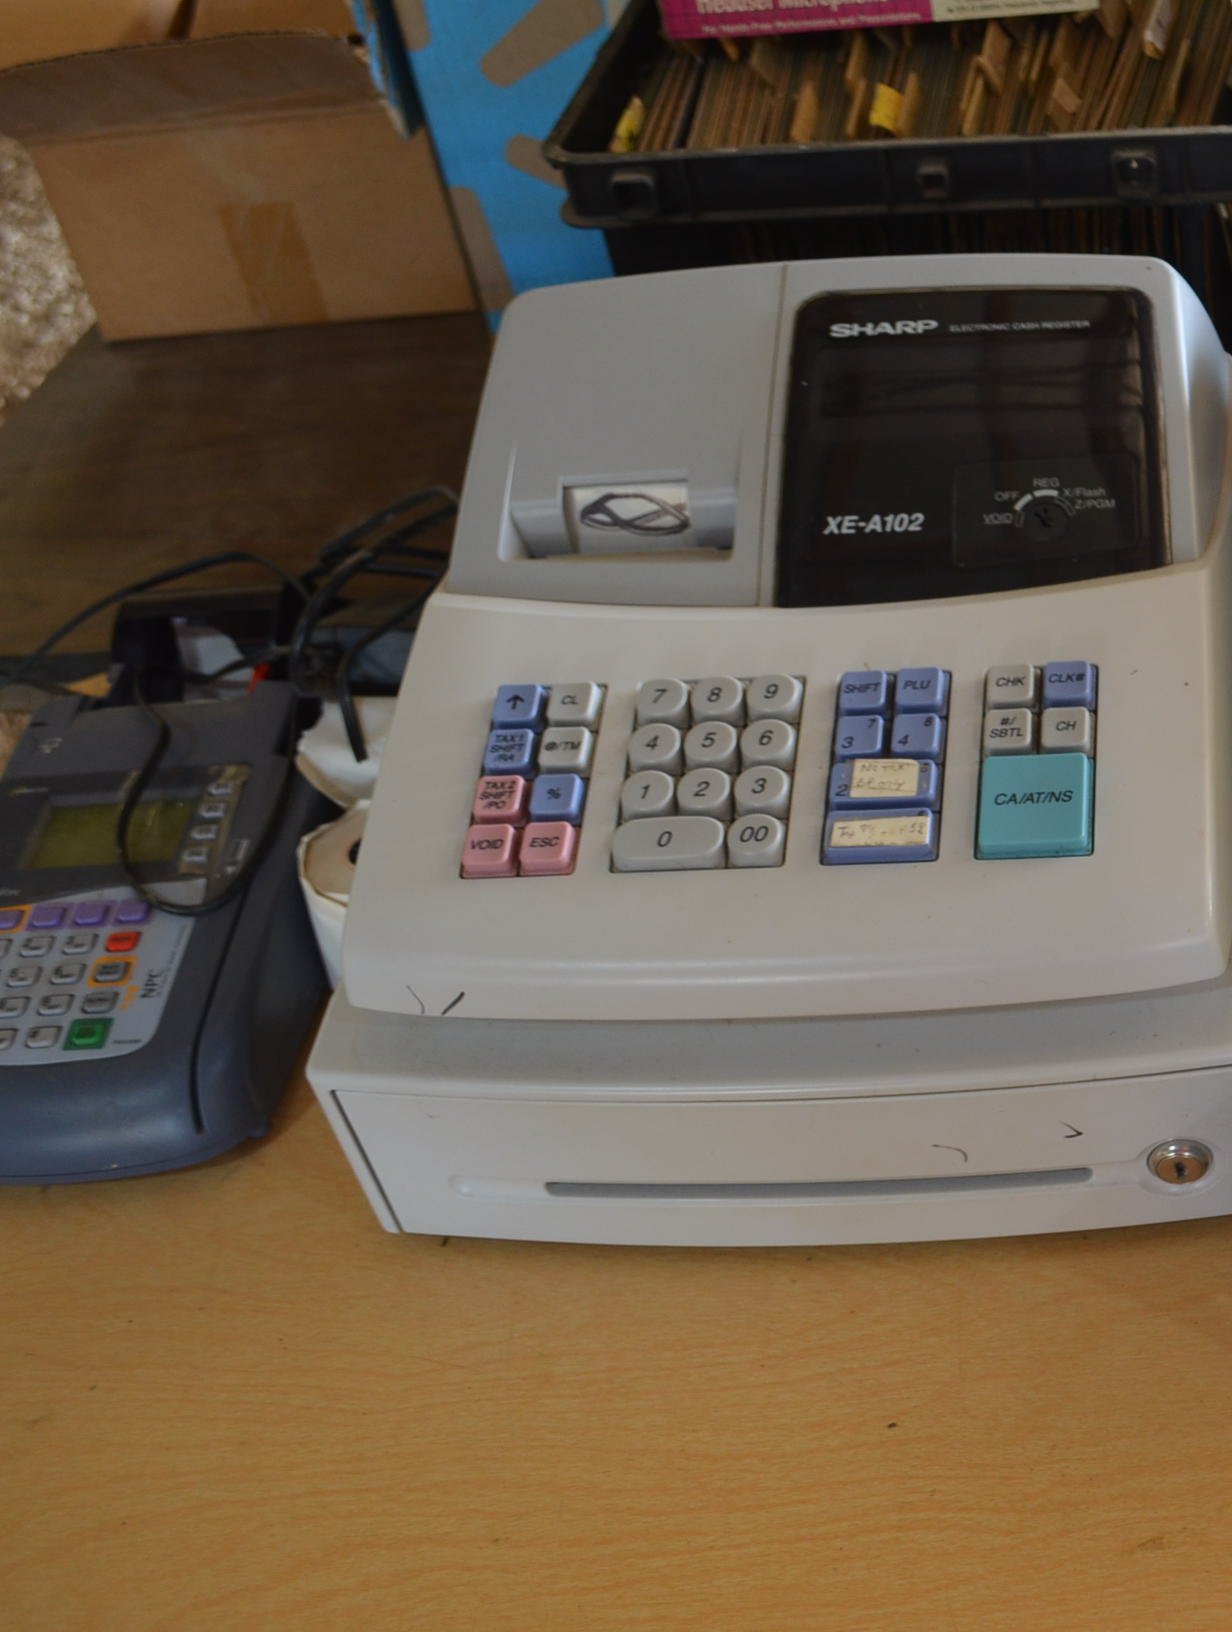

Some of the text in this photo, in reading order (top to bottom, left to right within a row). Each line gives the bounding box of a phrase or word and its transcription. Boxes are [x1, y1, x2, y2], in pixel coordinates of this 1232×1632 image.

[830, 320, 1090, 337] SHARP ELECTRONIC CASH REGISTER
[823, 513, 924, 535] XE-A102
[904, 680, 931, 690] PLU
[995, 676, 1026, 688] CHK
[1048, 672, 1085, 684] CLK#
[708, 687, 721, 702] 8
[764, 684, 778, 700] 9
[844, 682, 880, 694] SHIFT
[652, 689, 667, 704] 7
[868, 718, 876, 728] 7
[1056, 720, 1076, 731] CH
[702, 732, 716, 748] 5
[759, 730, 773, 746] 6
[897, 734, 909, 746] 4
[990, 728, 1022, 738] SBTL
[645, 734, 659, 750] 4
[841, 736, 853, 749] 3
[641, 784, 650, 799] 1
[694, 781, 710, 797] 2
[752, 778, 767, 793] 3
[836, 784, 848, 797] 2
[994, 790, 1073, 806] CA/AT/NS
[658, 831, 672, 847] 0
[739, 825, 768, 842] 00
[471, 838, 504, 849] VOID
[530, 836, 560, 847] ESC
